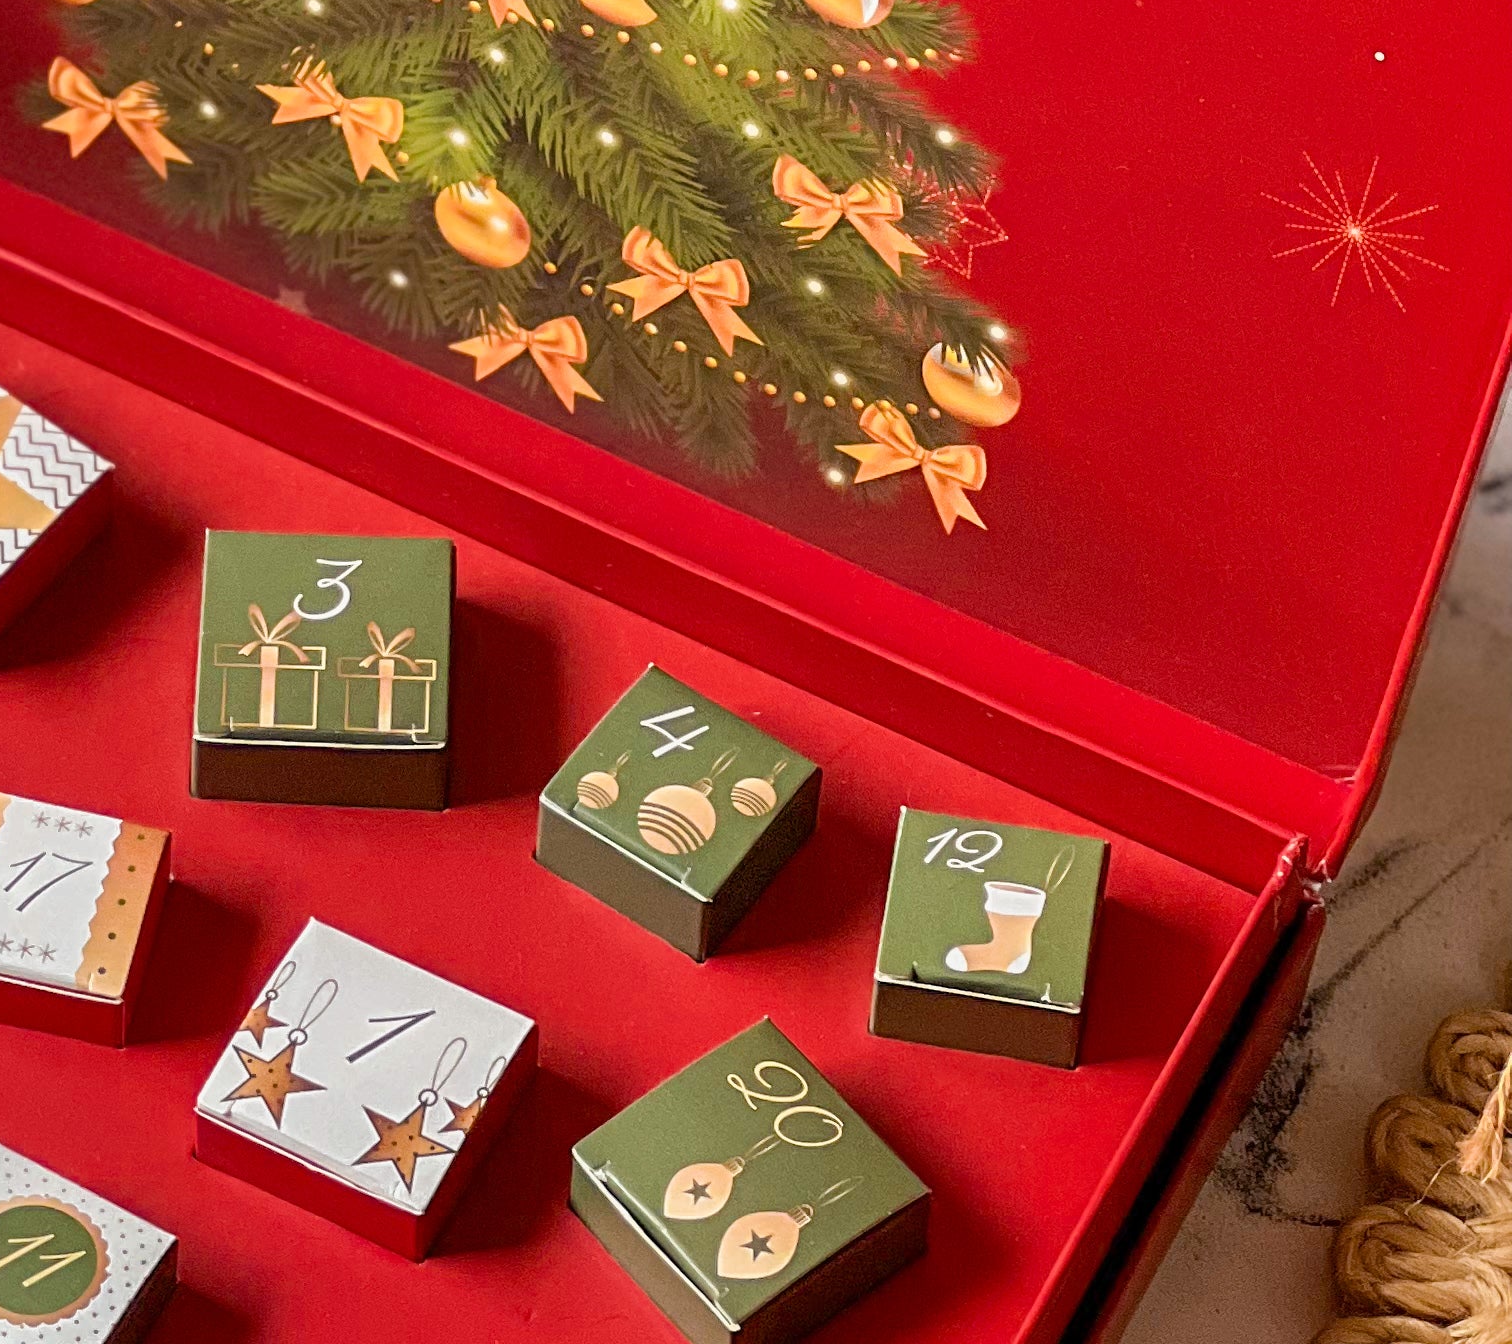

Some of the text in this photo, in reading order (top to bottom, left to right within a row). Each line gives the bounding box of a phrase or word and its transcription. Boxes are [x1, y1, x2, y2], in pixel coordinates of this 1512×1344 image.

[293, 559, 362, 620] 3
[640, 706, 709, 757] 4
[924, 828, 1003, 872] 12
[4, 852, 93, 912] 17
[346, 1010, 436, 1064] 1
[727, 1061, 844, 1147] 20
